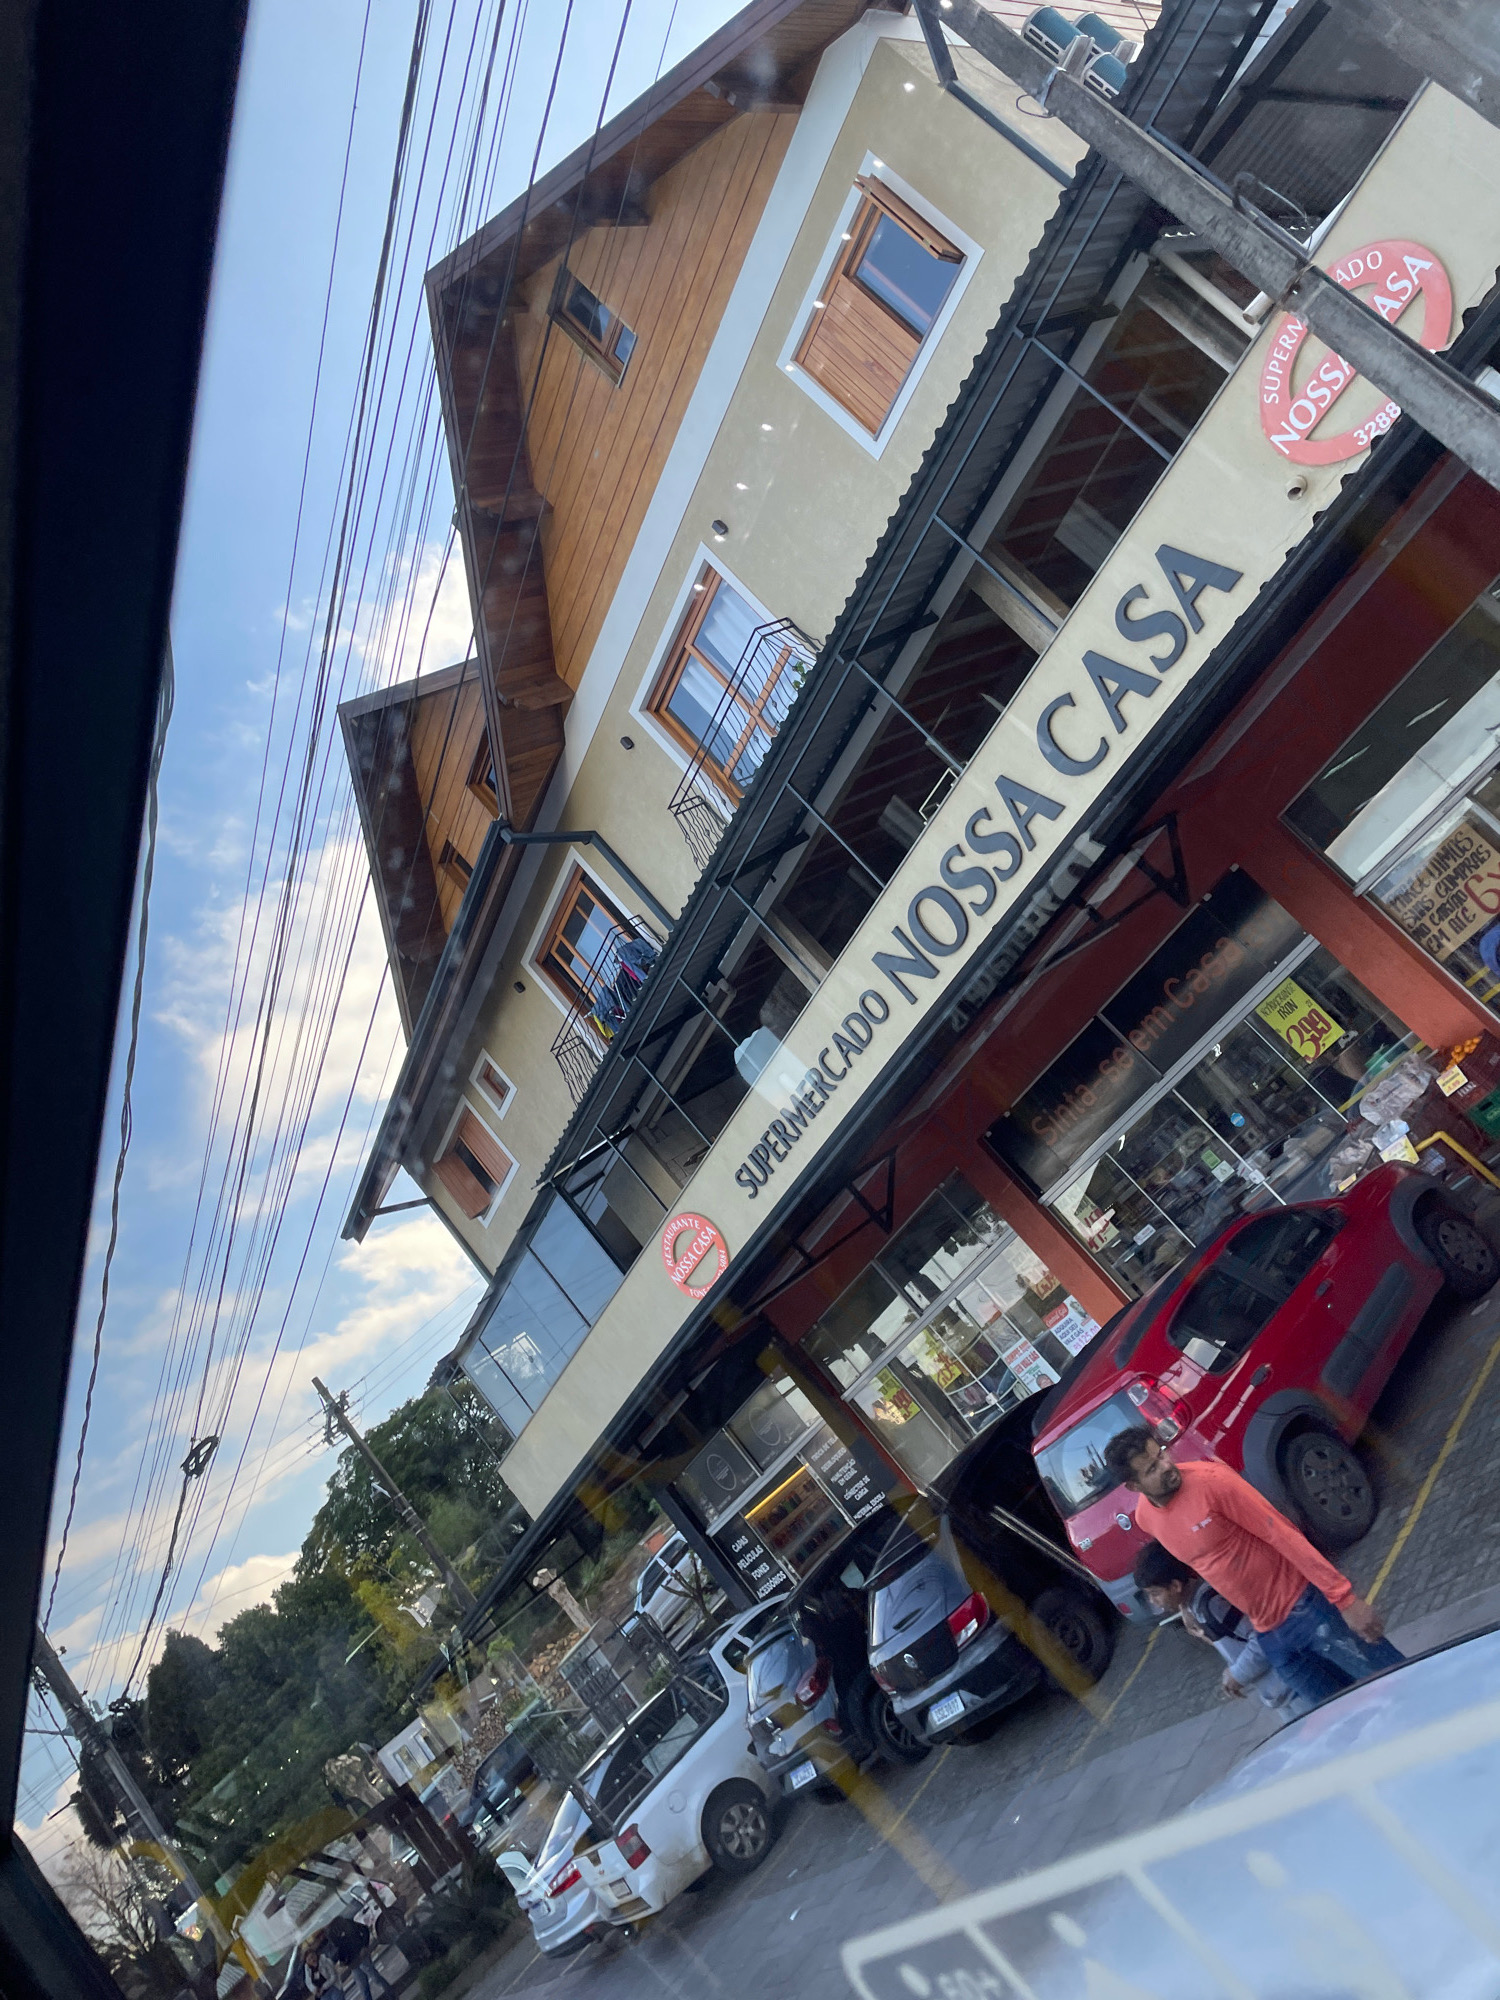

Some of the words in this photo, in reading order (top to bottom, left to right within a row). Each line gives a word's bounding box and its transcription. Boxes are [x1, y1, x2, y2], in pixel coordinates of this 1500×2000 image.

[1374, 255, 1433, 322] ASA
[734, 989, 890, 1200] SUPERMERCADO
[871, 774, 1066, 1005] NOSSA
[1036, 544, 1244, 777] CASA
[1435, 844, 1492, 897] COMPRAS
[1426, 928, 1450, 954] EM
[1128, 1005, 1175, 1050] em
[1163, 937, 1246, 1009] Casa
[663, 1218, 701, 1267] RESTAURANTE
[671, 1251, 698, 1286] NOSSA
[692, 1226, 717, 1255] CASA
[1054, 1318, 1073, 1334] ADQUIRA
[1059, 1328, 1070, 1340] AQUI
[1069, 1323, 1078, 1333] SEU
[1064, 1334, 1076, 1345] VALE
[731, 1535, 748, 1552] CAPAS
[737, 1544, 764, 1570] PELÍCULAS
[751, 1562, 770, 1580] FONES
[756, 1570, 787, 1599] ACESSÓRIOS
